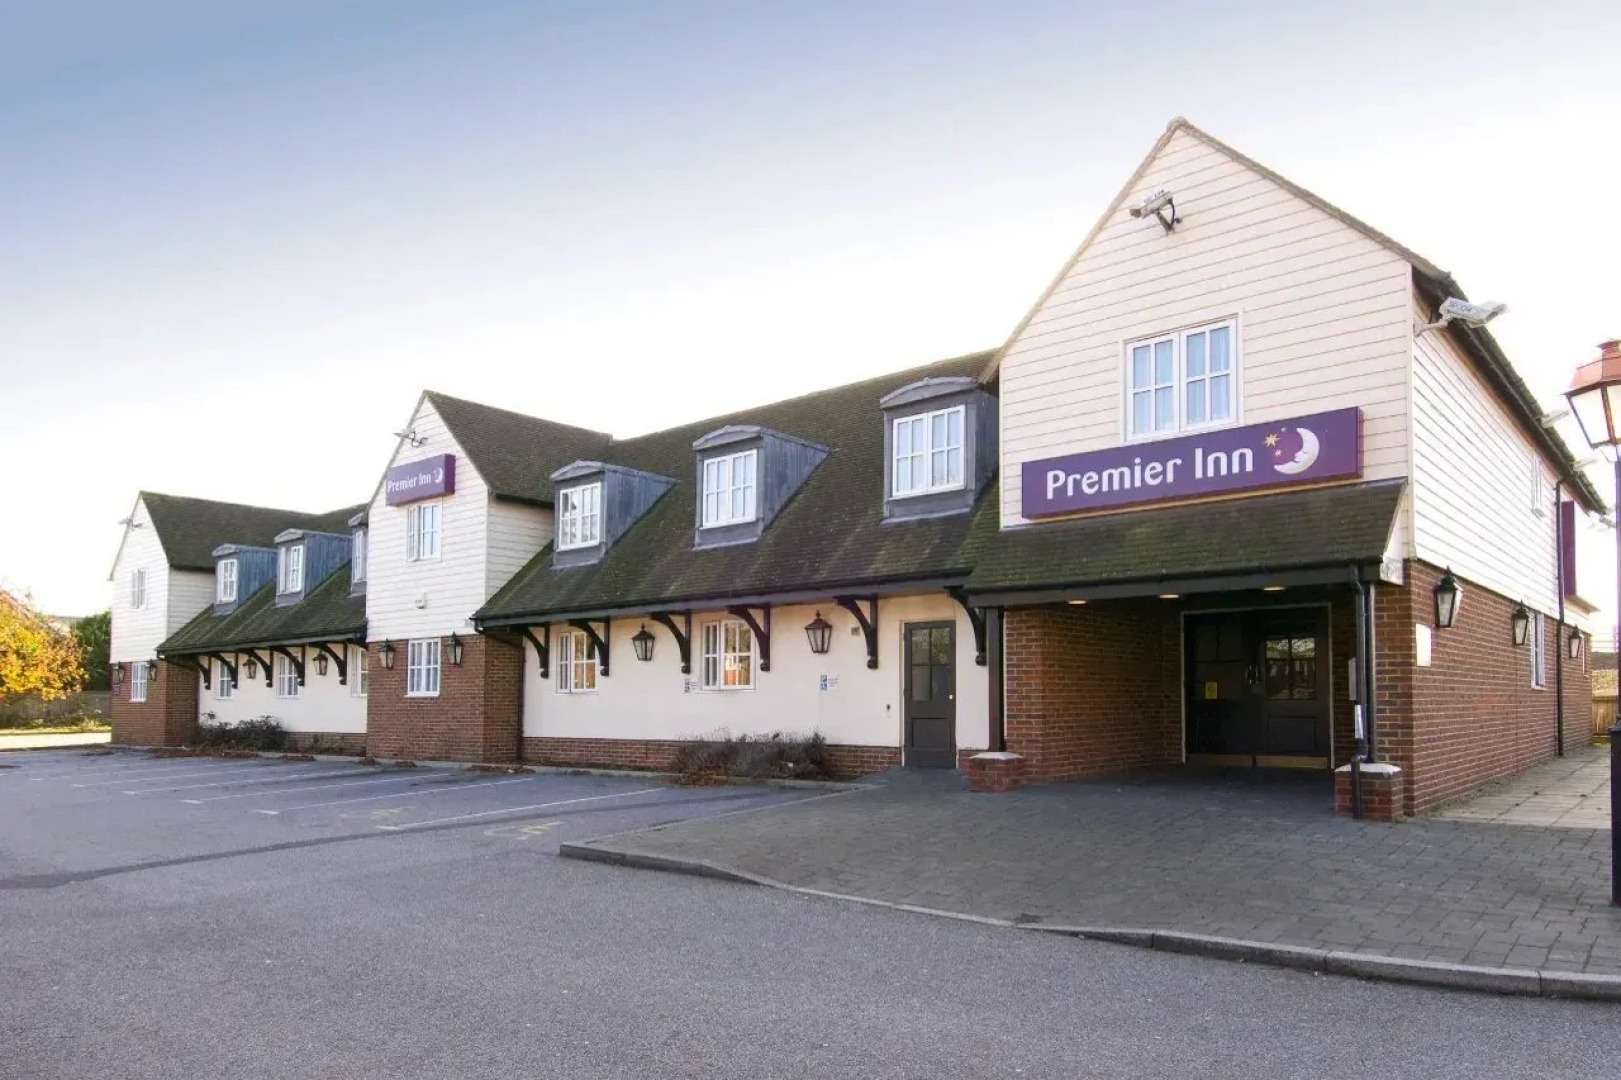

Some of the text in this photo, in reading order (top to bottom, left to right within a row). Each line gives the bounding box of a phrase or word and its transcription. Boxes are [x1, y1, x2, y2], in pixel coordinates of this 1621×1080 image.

[387, 473, 432, 493] Premier Inn
[1046, 447, 1254, 500] Premier Inn
